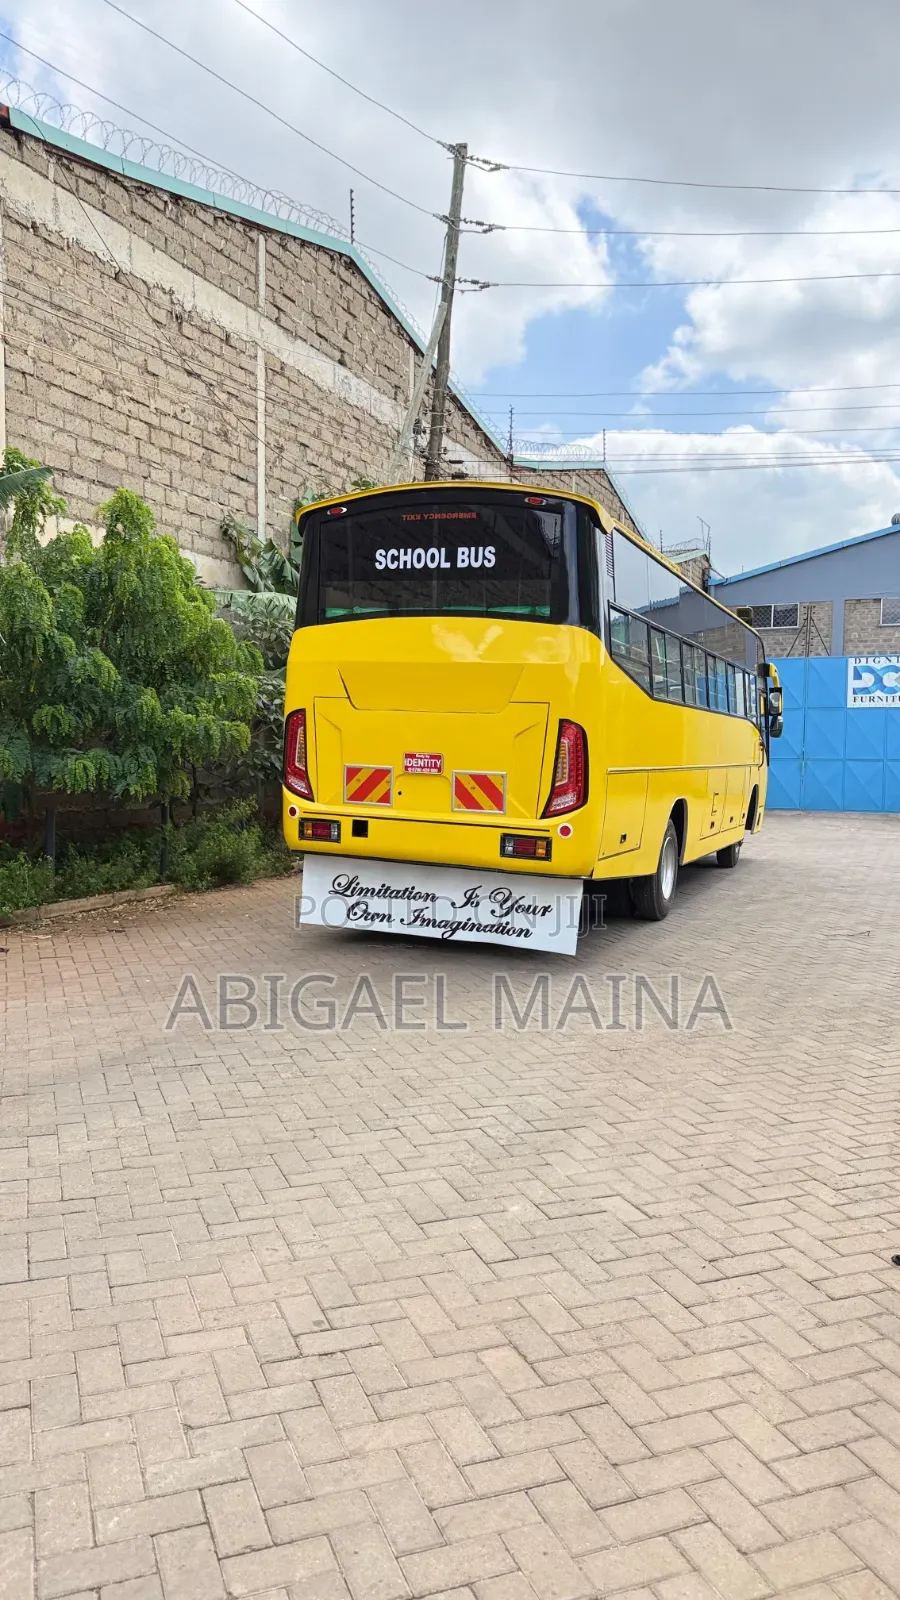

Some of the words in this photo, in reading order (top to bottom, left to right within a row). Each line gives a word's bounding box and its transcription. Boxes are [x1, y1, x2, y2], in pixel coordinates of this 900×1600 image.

[375, 547, 451, 570] SCHOOL
[456, 546, 496, 568] BUS
[404, 758, 441, 767] IDENTITY
[328, 873, 439, 903] Limitation
[450, 885, 482, 909] Is
[489, 887, 553, 918] Your
[346, 900, 395, 923] Own
[399, 906, 533, 940] Imagination
